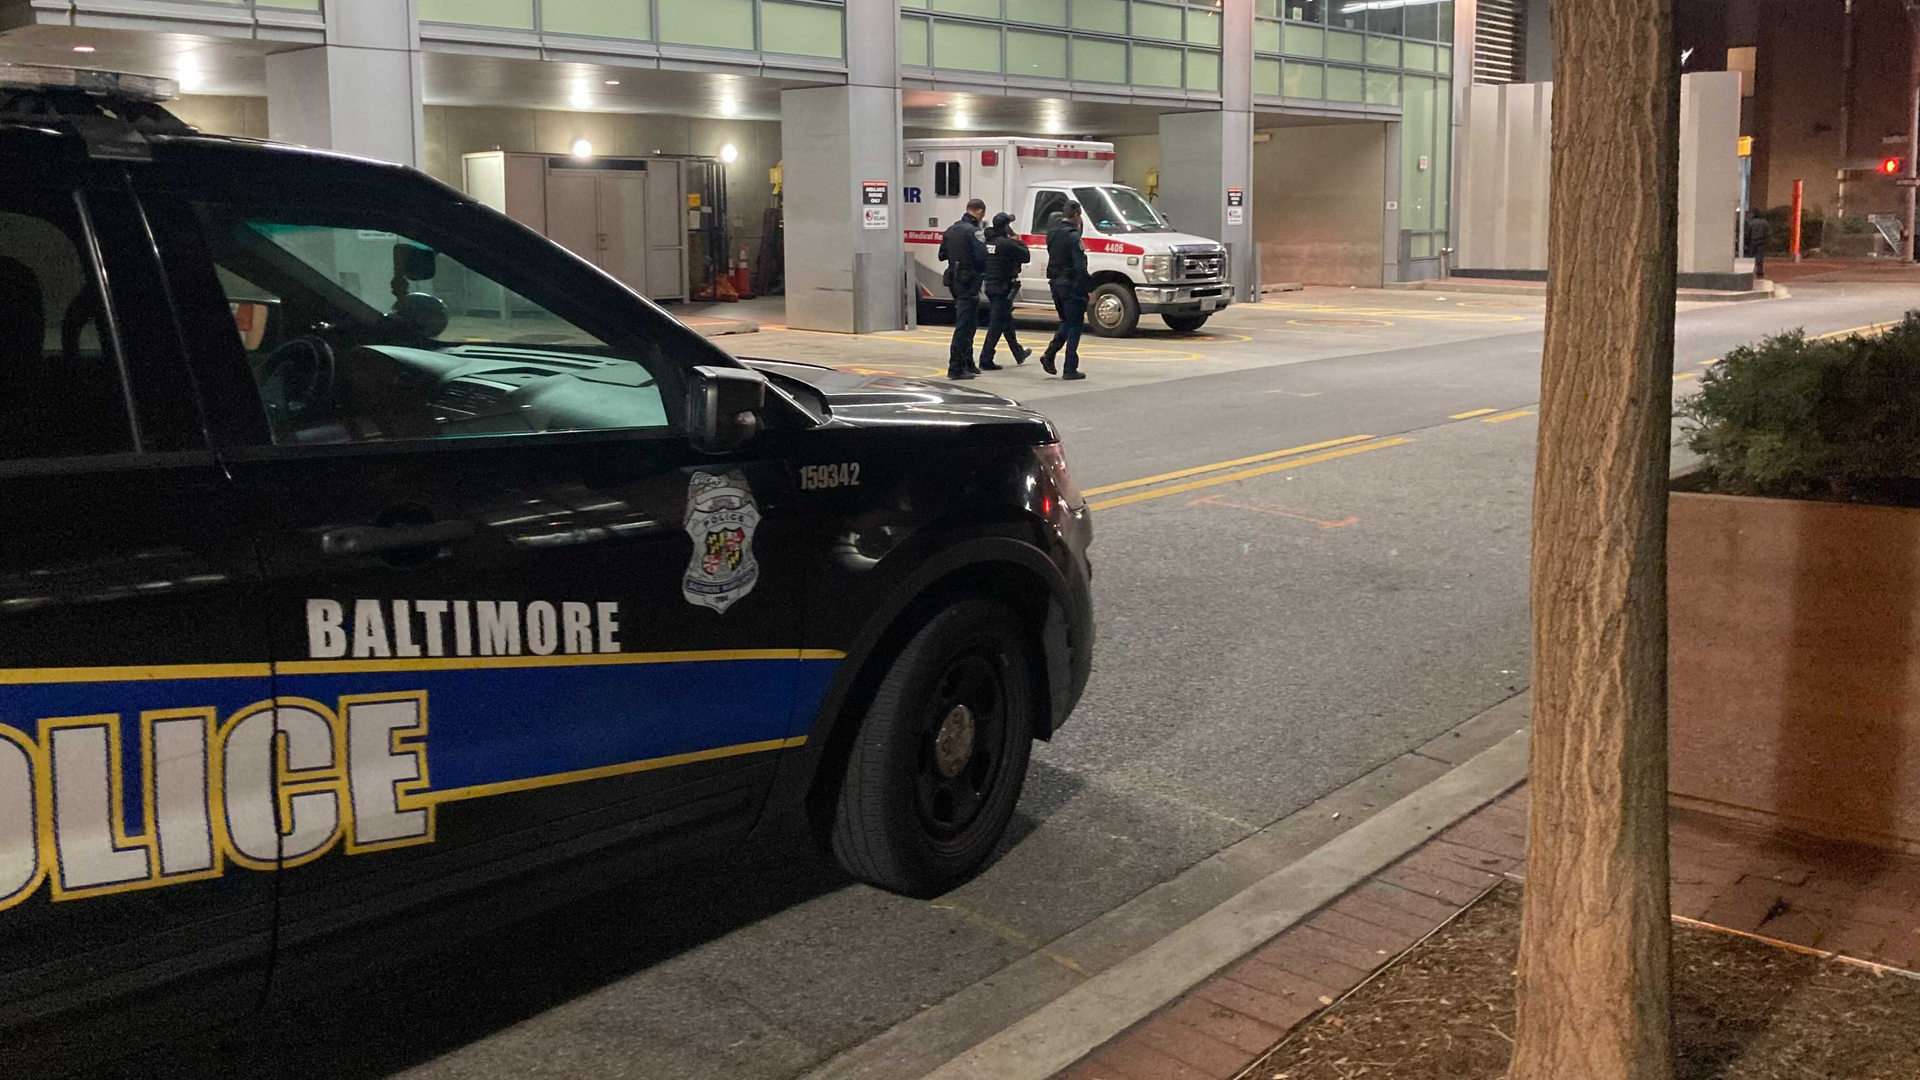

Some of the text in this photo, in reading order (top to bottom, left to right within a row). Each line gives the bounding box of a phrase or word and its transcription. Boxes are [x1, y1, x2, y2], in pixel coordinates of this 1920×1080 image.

[909, 232, 933, 240] Medical
[799, 463, 860, 490] 159342
[703, 514, 744, 528] POLICE
[306, 599, 621, 658] BALTIMORE
